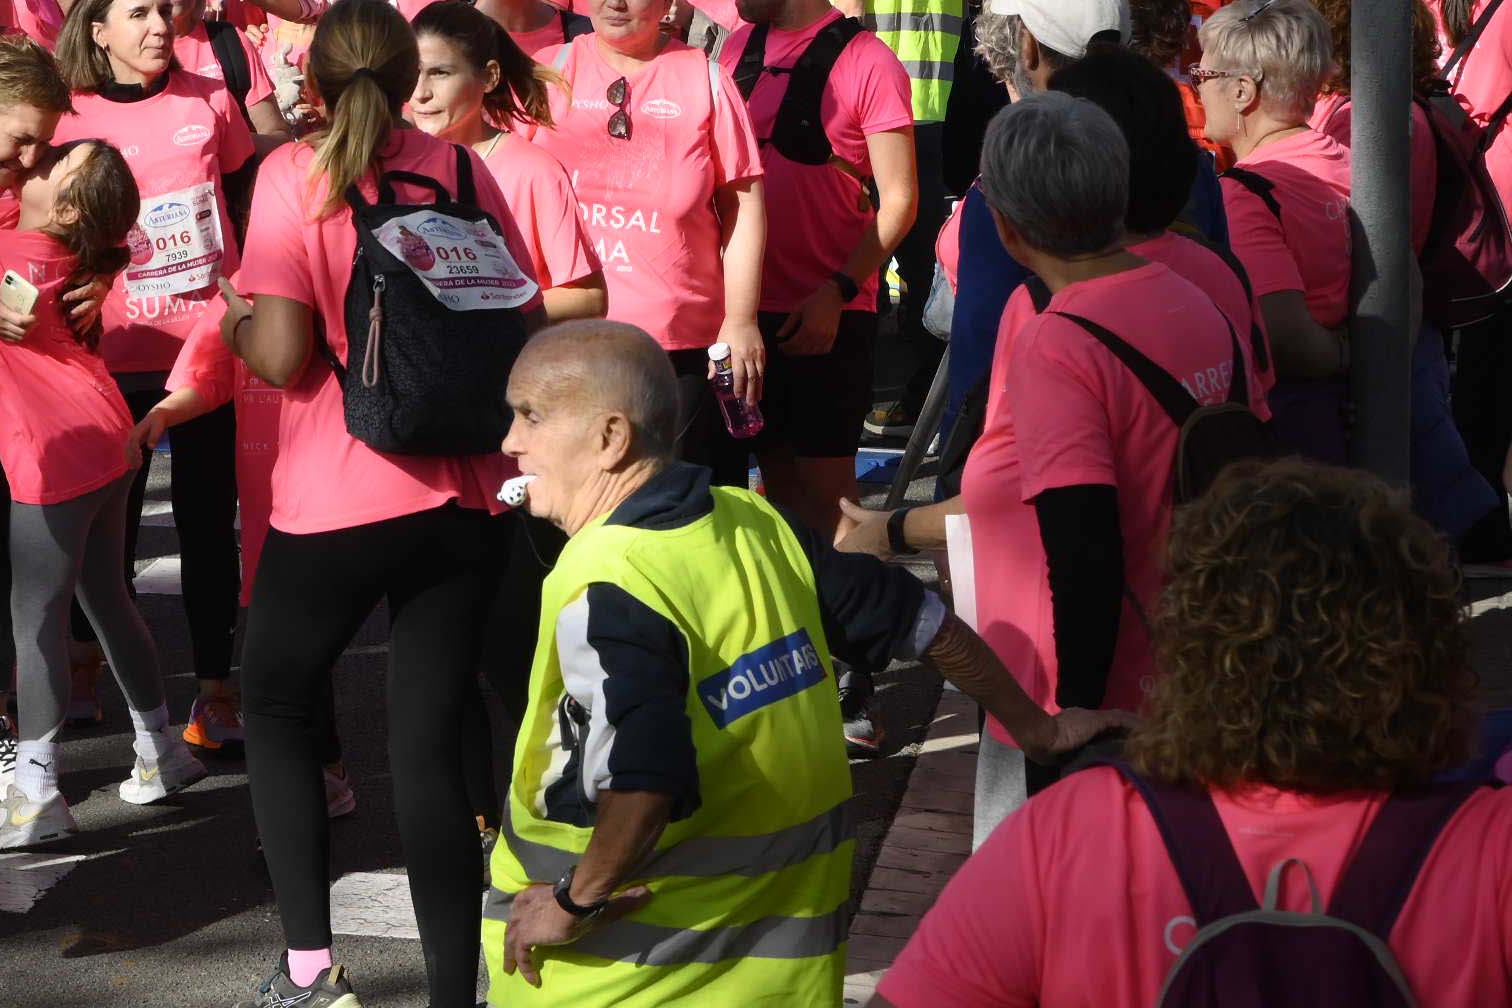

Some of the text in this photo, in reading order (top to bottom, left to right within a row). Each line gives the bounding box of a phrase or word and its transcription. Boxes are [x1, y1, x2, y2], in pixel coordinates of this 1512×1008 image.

[149, 208, 187, 226] ASTURIANA
[155, 230, 192, 251] 016
[166, 249, 188, 263] 7939
[437, 246, 477, 262] 016
[138, 268, 167, 279] CARRERA
